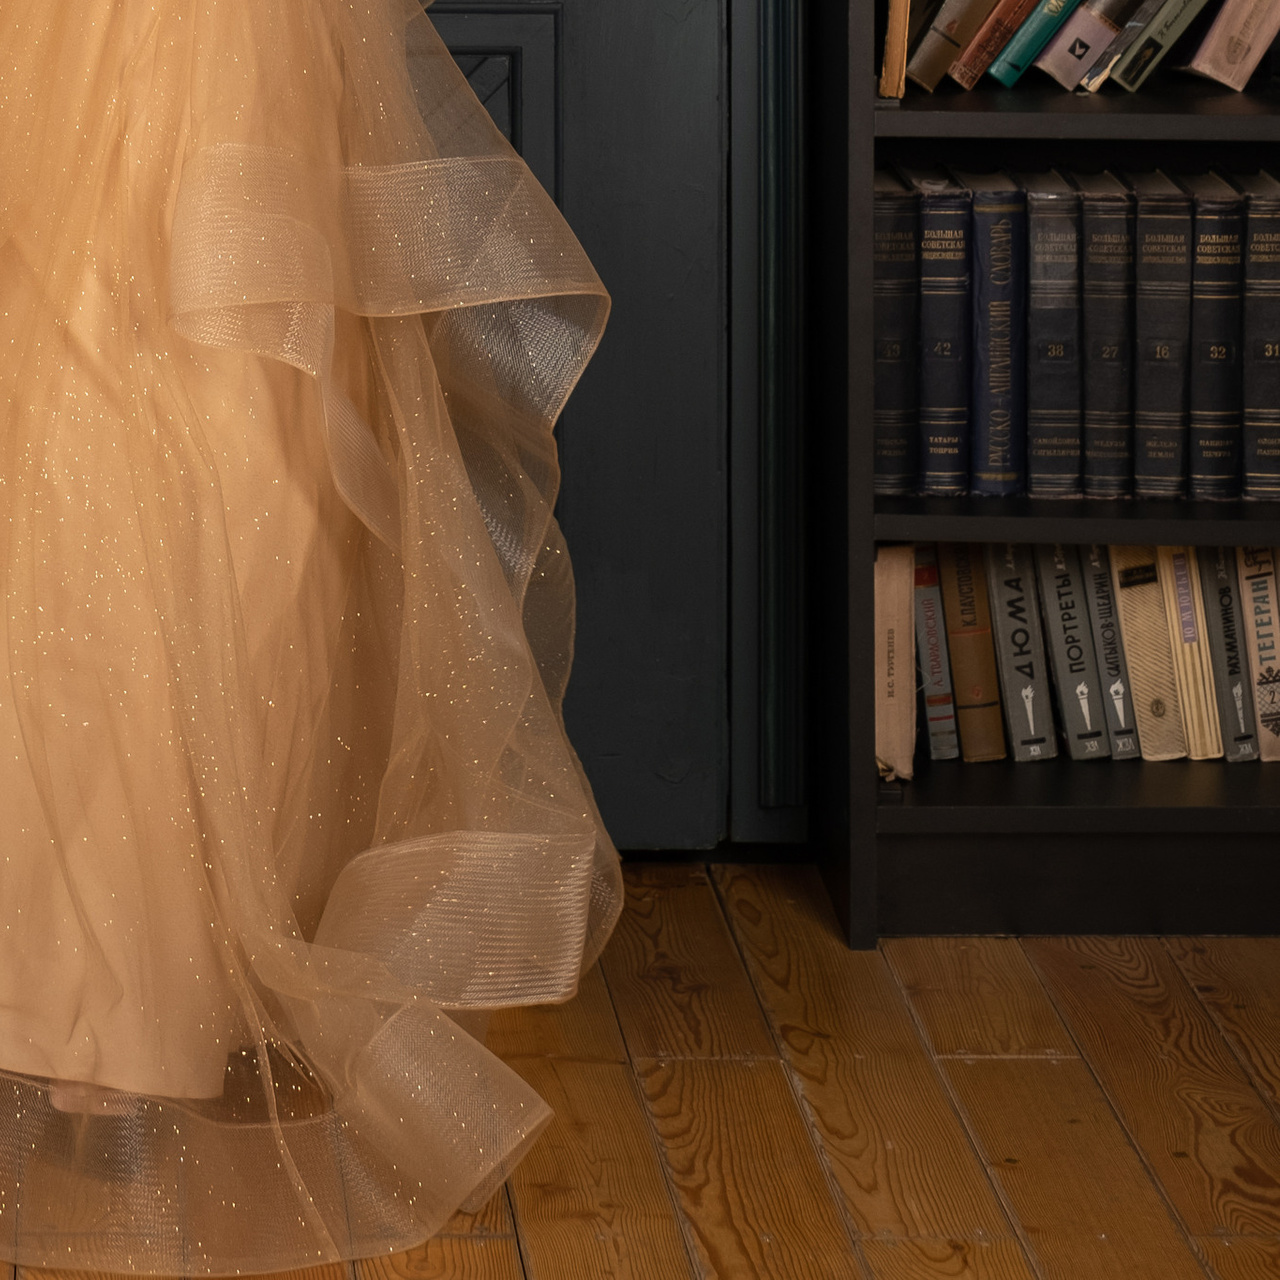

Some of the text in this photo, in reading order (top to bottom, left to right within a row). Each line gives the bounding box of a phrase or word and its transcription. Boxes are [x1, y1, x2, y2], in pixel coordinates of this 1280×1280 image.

[924, 229, 964, 239] БОЛЬШАЯ
[921, 239, 965, 249] СОВЕТСКАЯ
[1196, 244, 1241, 254] СОВЕТСКАЯ
[990, 218, 1012, 286] СЛОВАРЬ
[933, 342, 951, 356] 42
[1047, 343, 1064, 357] 38
[1101, 345, 1119, 358] 27
[1155, 344, 1170, 358] 16
[1210, 345, 1226, 359] 32
[1003, 577, 1035, 681] ДЮМА
[1055, 573, 1086, 674] ПОРТРЕТЫ
[1092, 573, 1122, 679] САЛТЫКОВ-ЩЕДРИН
[1252, 579, 1276, 667] ТЕГЕРАН
[1218, 585, 1240, 676] РАХМАНИНОВ
[1269, 690, 1276, 705] 2
